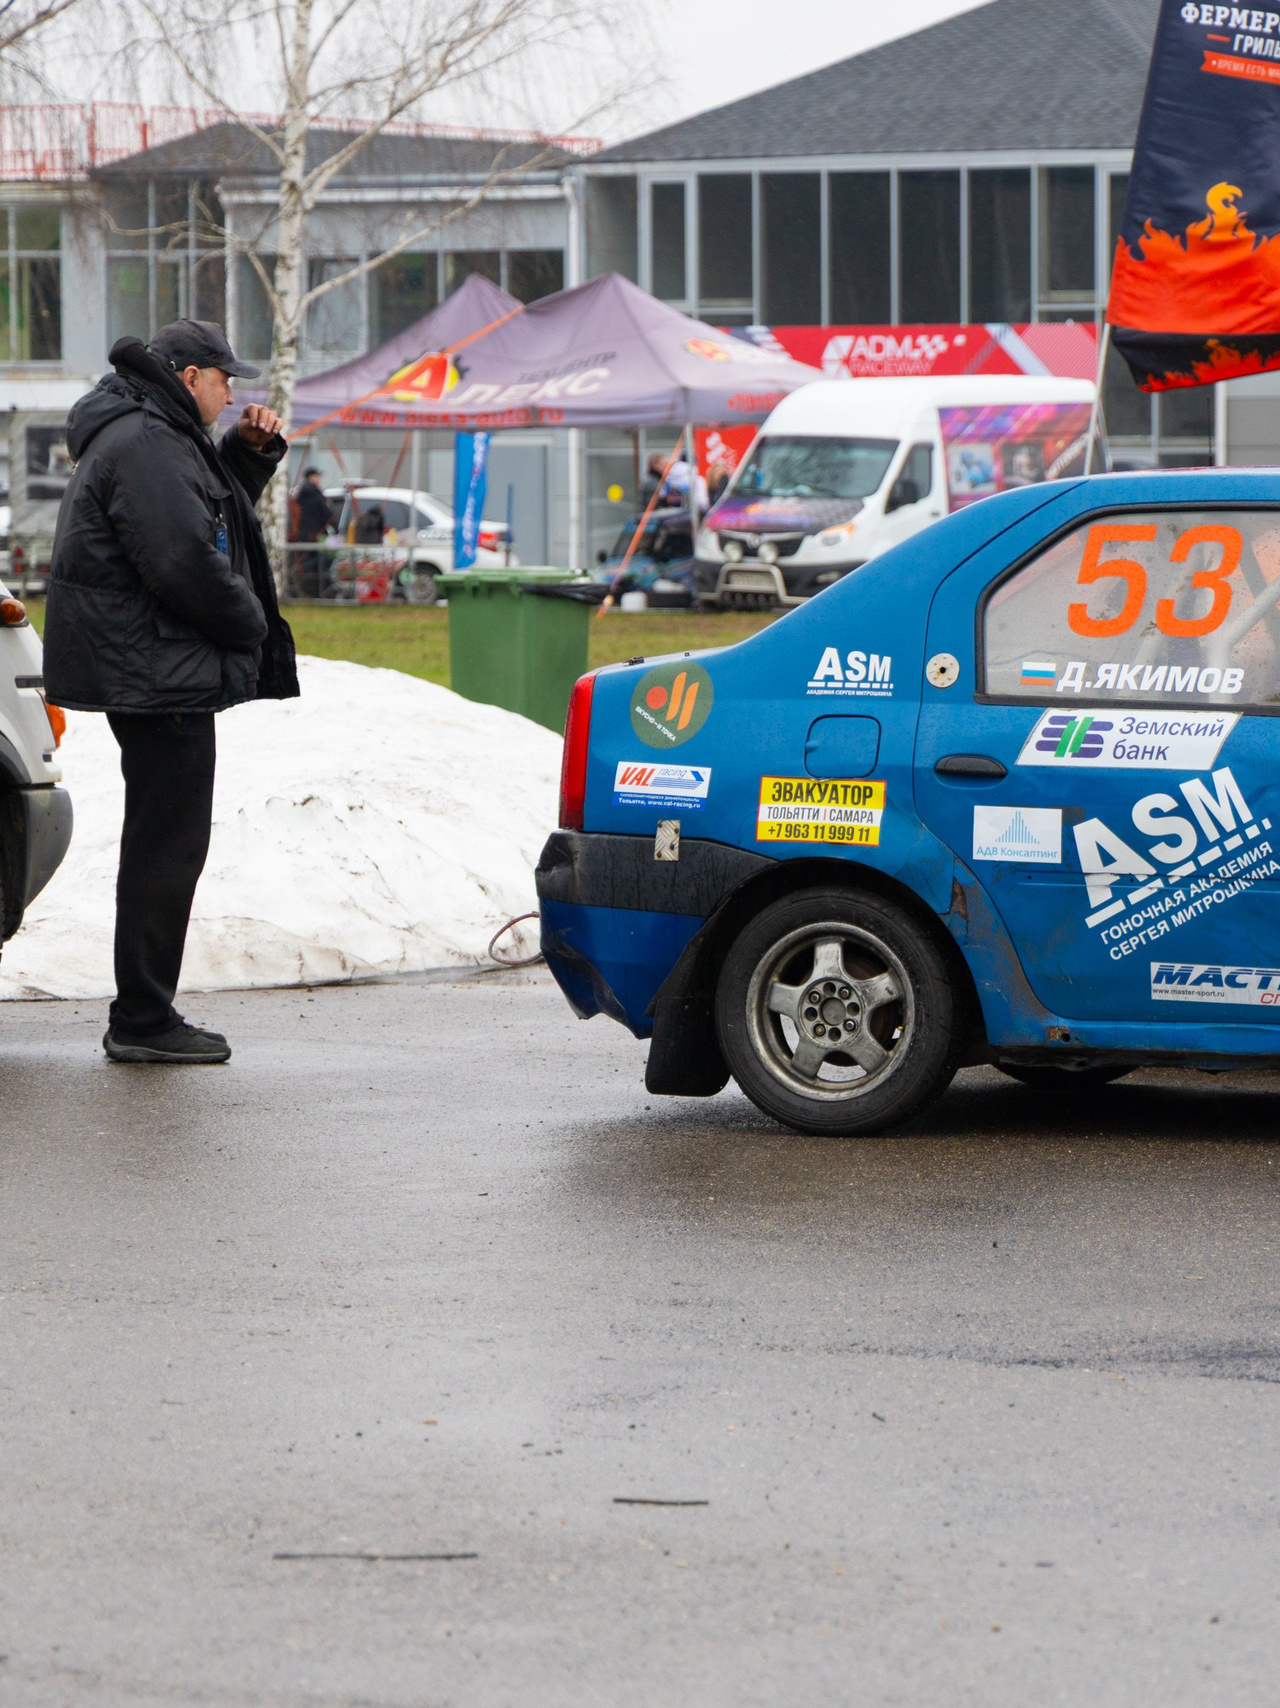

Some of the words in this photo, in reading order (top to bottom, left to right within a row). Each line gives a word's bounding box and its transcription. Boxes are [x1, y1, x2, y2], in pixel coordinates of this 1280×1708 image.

[1245, 63, 1266, 76] ЕСТЬ
[851, 335, 909, 360] ADM
[1068, 524, 1243, 637] 53
[813, 647, 891, 682] ASM
[1056, 662, 1245, 694] Д.ЯКИМОВ
[635, 706, 655, 724] ВКУСНО
[661, 727, 676, 741] ТОЧКА
[1119, 717, 1226, 738] Земский
[1112, 740, 1169, 761] банк
[619, 767, 655, 786] VAL
[658, 768, 687, 778] racing
[618, 797, 646, 806] Тольятти,
[647, 800, 701, 809] www.val-racing.ru
[772, 782, 873, 806] ЭВАКУАТОР
[767, 806, 820, 821] ТОЛЬЯТТИ
[829, 809, 874, 824] САМАРА
[768, 824, 782, 838] +7
[785, 824, 810, 839] 963
[813, 825, 826, 840] 11
[829, 825, 854, 841] 999
[858, 828, 870, 842] 11
[1072, 767, 1253, 909] ASM
[976, 846, 998, 856] АДВ
[1000, 847, 1059, 858] Консалтинг
[1100, 889, 1186, 944] ГОНОЧНАЯ
[1190, 841, 1273, 899] АКАДЕМИЯ
[1109, 920, 1171, 960] СЕРГЕЯ
[1152, 988, 1225, 997] www.master-sport.ru
